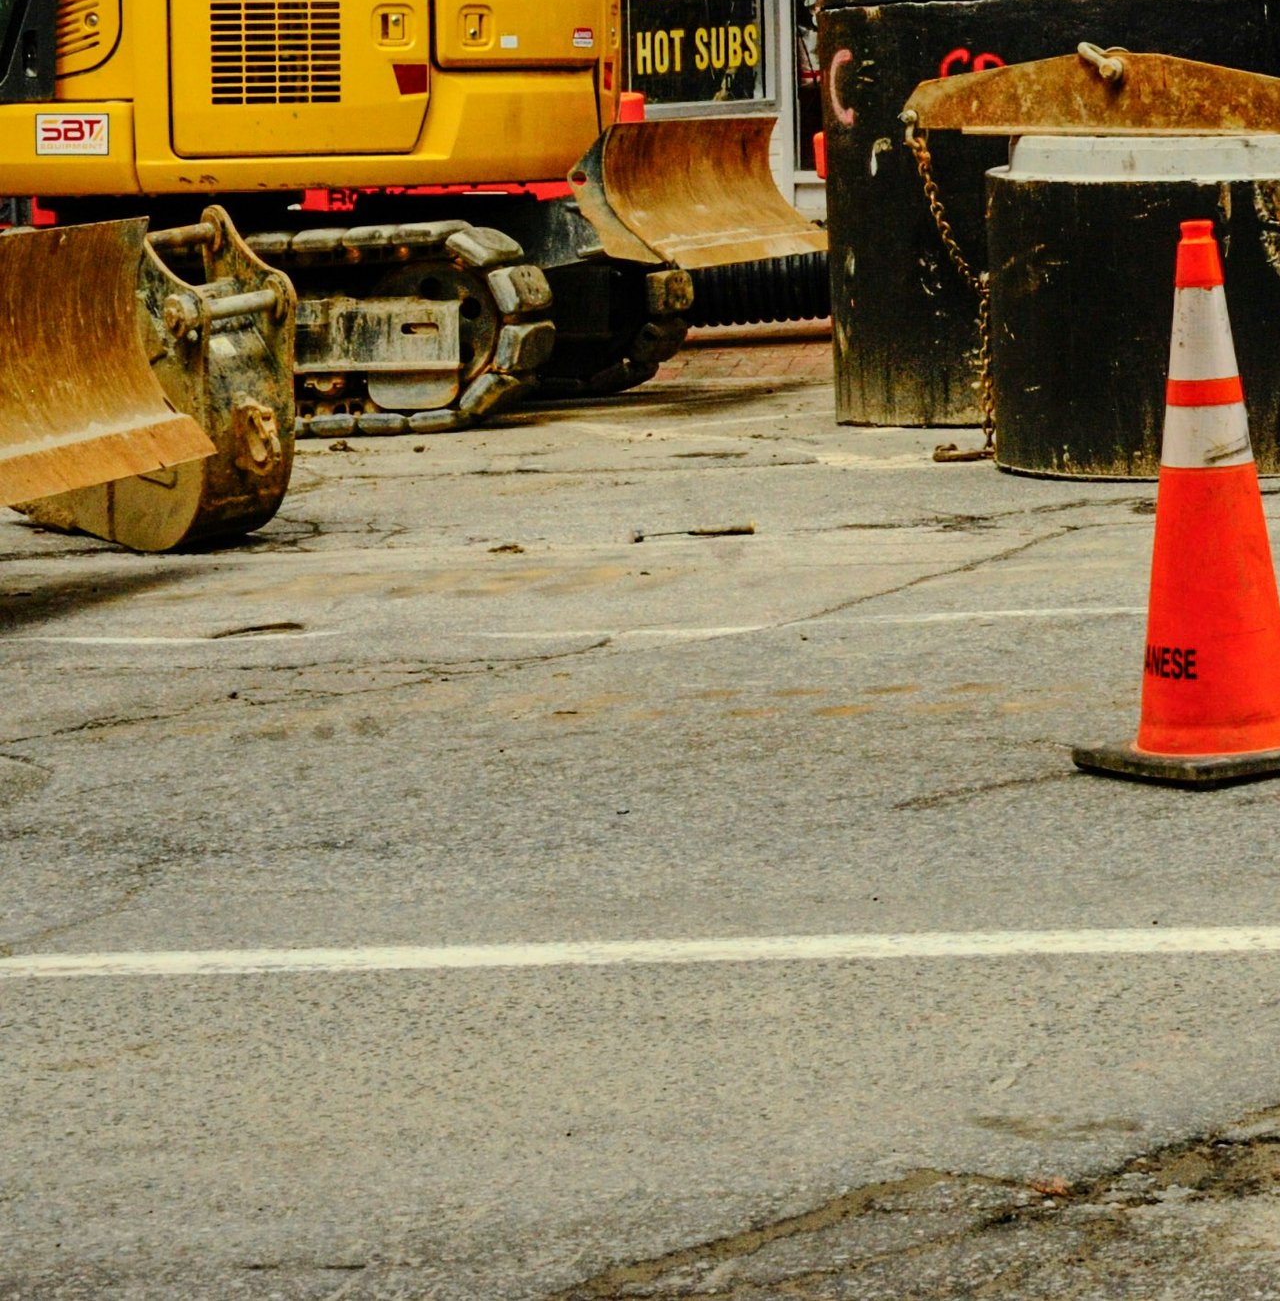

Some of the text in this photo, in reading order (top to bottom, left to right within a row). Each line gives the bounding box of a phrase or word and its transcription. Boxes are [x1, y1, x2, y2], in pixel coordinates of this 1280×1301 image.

[636, 24, 759, 75] HOT SUBS
[41, 119, 103, 141] SBT
